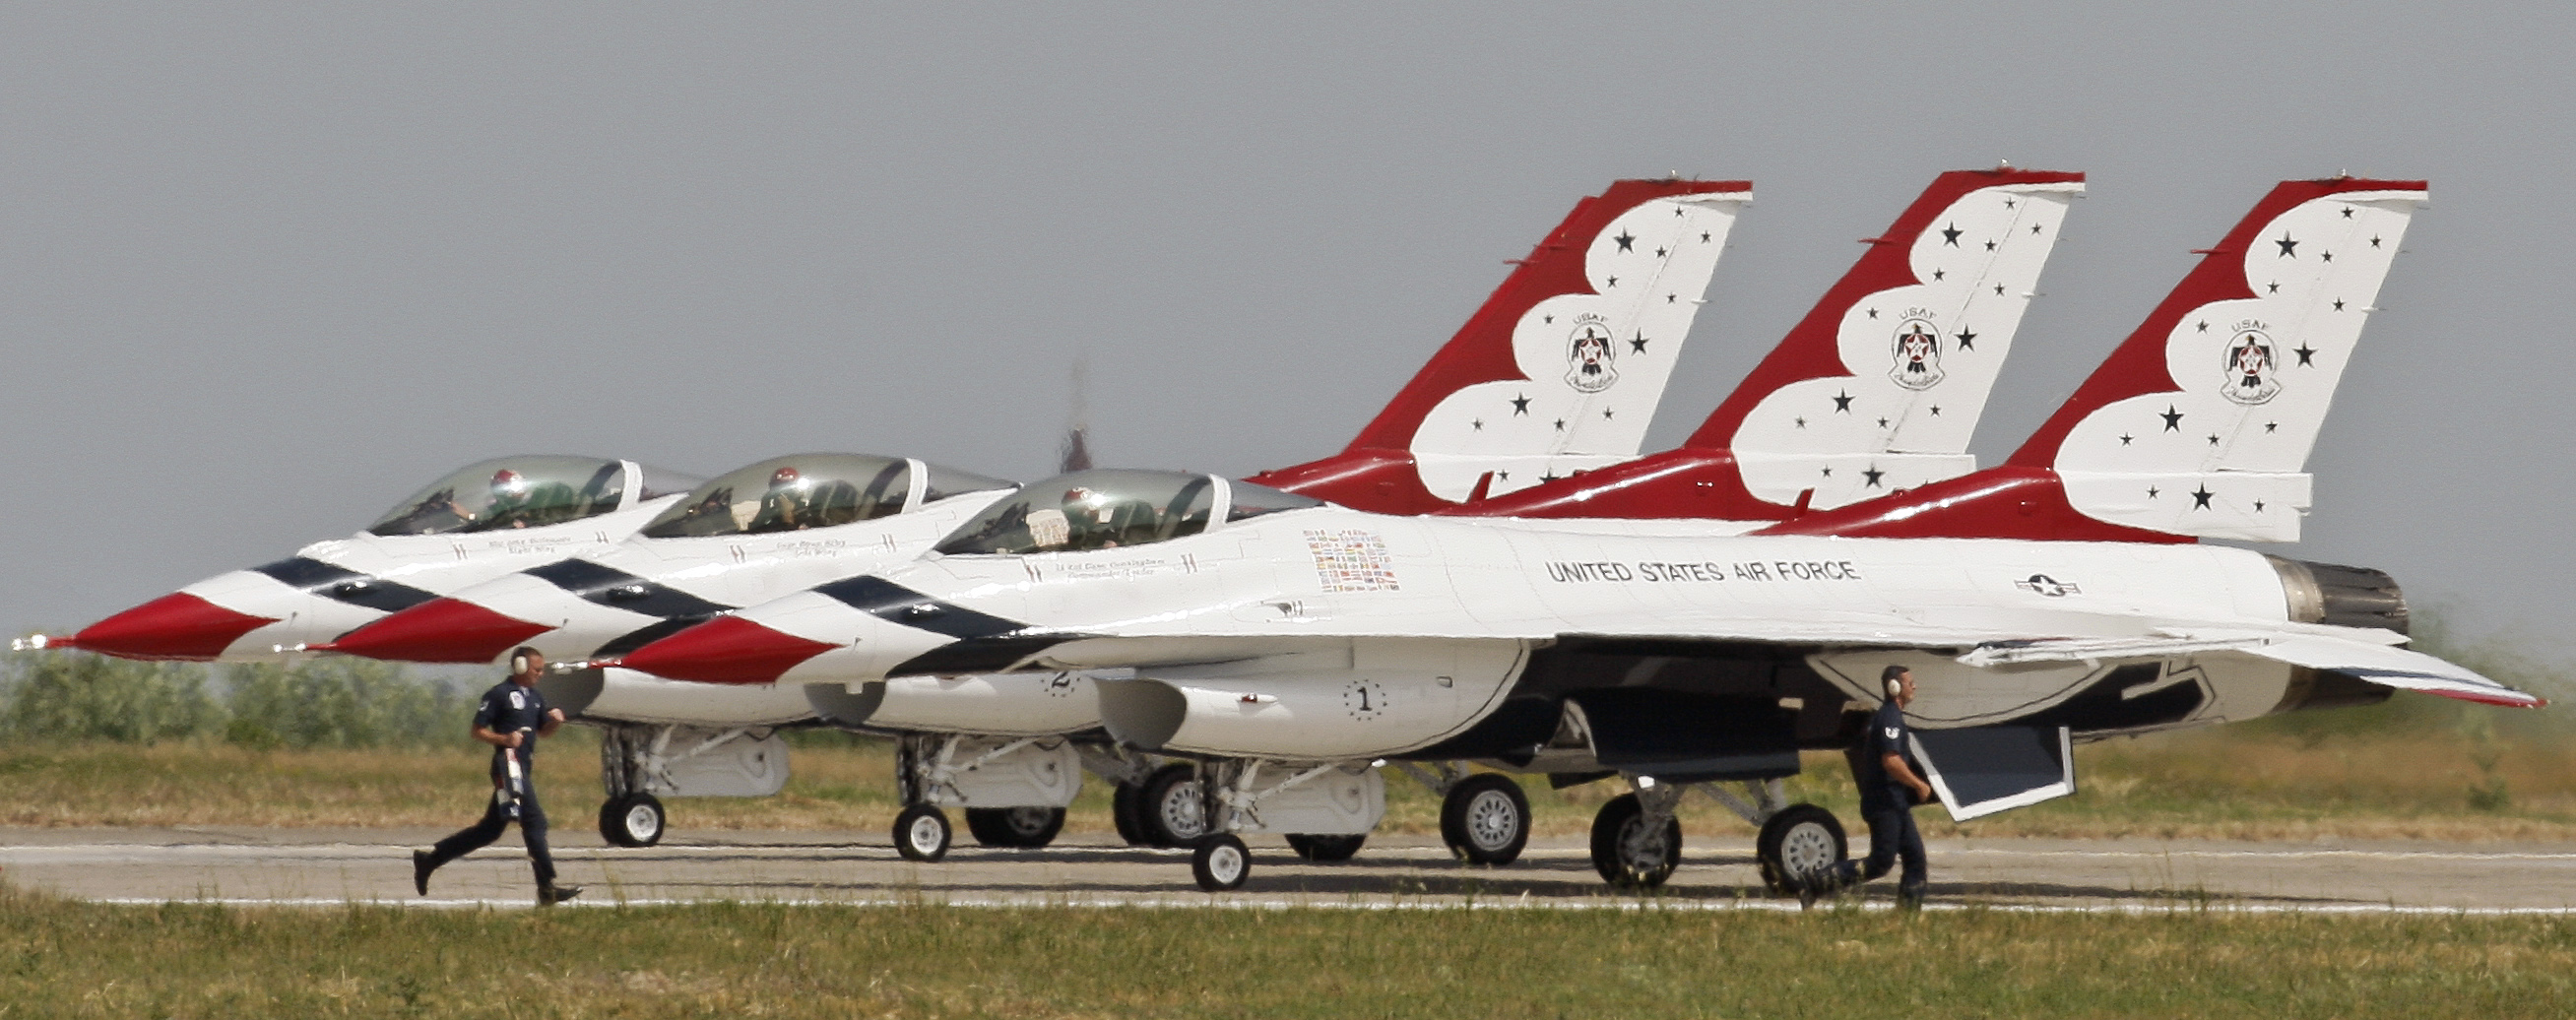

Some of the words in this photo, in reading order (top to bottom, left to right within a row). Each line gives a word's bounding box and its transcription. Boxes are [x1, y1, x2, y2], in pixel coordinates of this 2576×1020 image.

[1573, 312, 1609, 324] USAF
[1899, 307, 1938, 320] USAF
[2231, 319, 2272, 332] USAF
[1546, 561, 1634, 583] UNITED
[1639, 561, 1726, 582] STATES
[1733, 561, 1772, 582] AIR
[1775, 560, 1863, 581] FORCE
[1051, 671, 1071, 688] 2
[1357, 686, 1373, 712] 1
